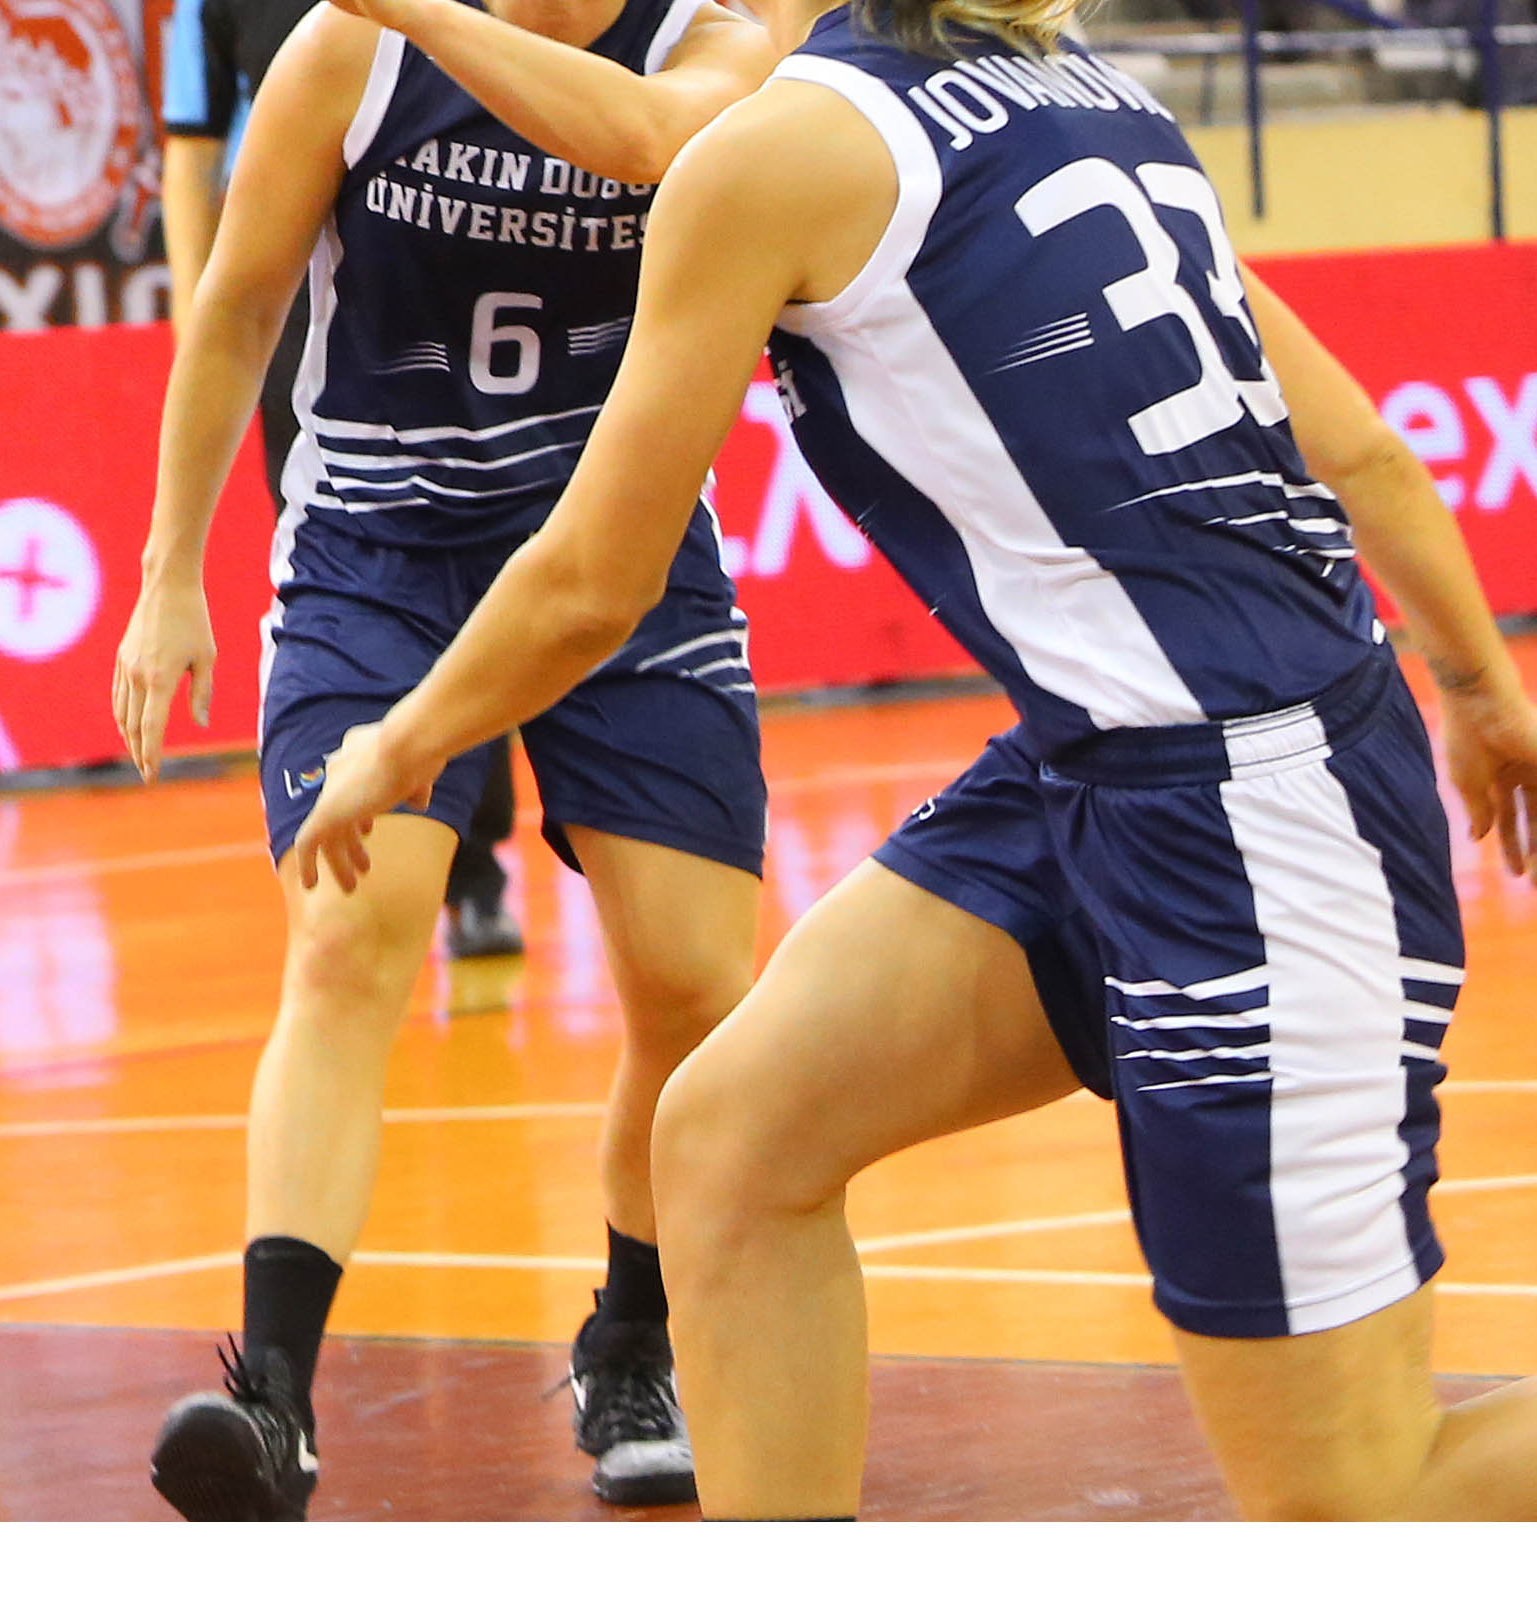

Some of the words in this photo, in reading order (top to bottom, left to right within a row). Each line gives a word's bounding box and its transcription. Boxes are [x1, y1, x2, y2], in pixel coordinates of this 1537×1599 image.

[366, 169, 649, 251] ÜNİVERSİTE
[468, 291, 544, 396] 6
[1013, 156, 1289, 457] 33
